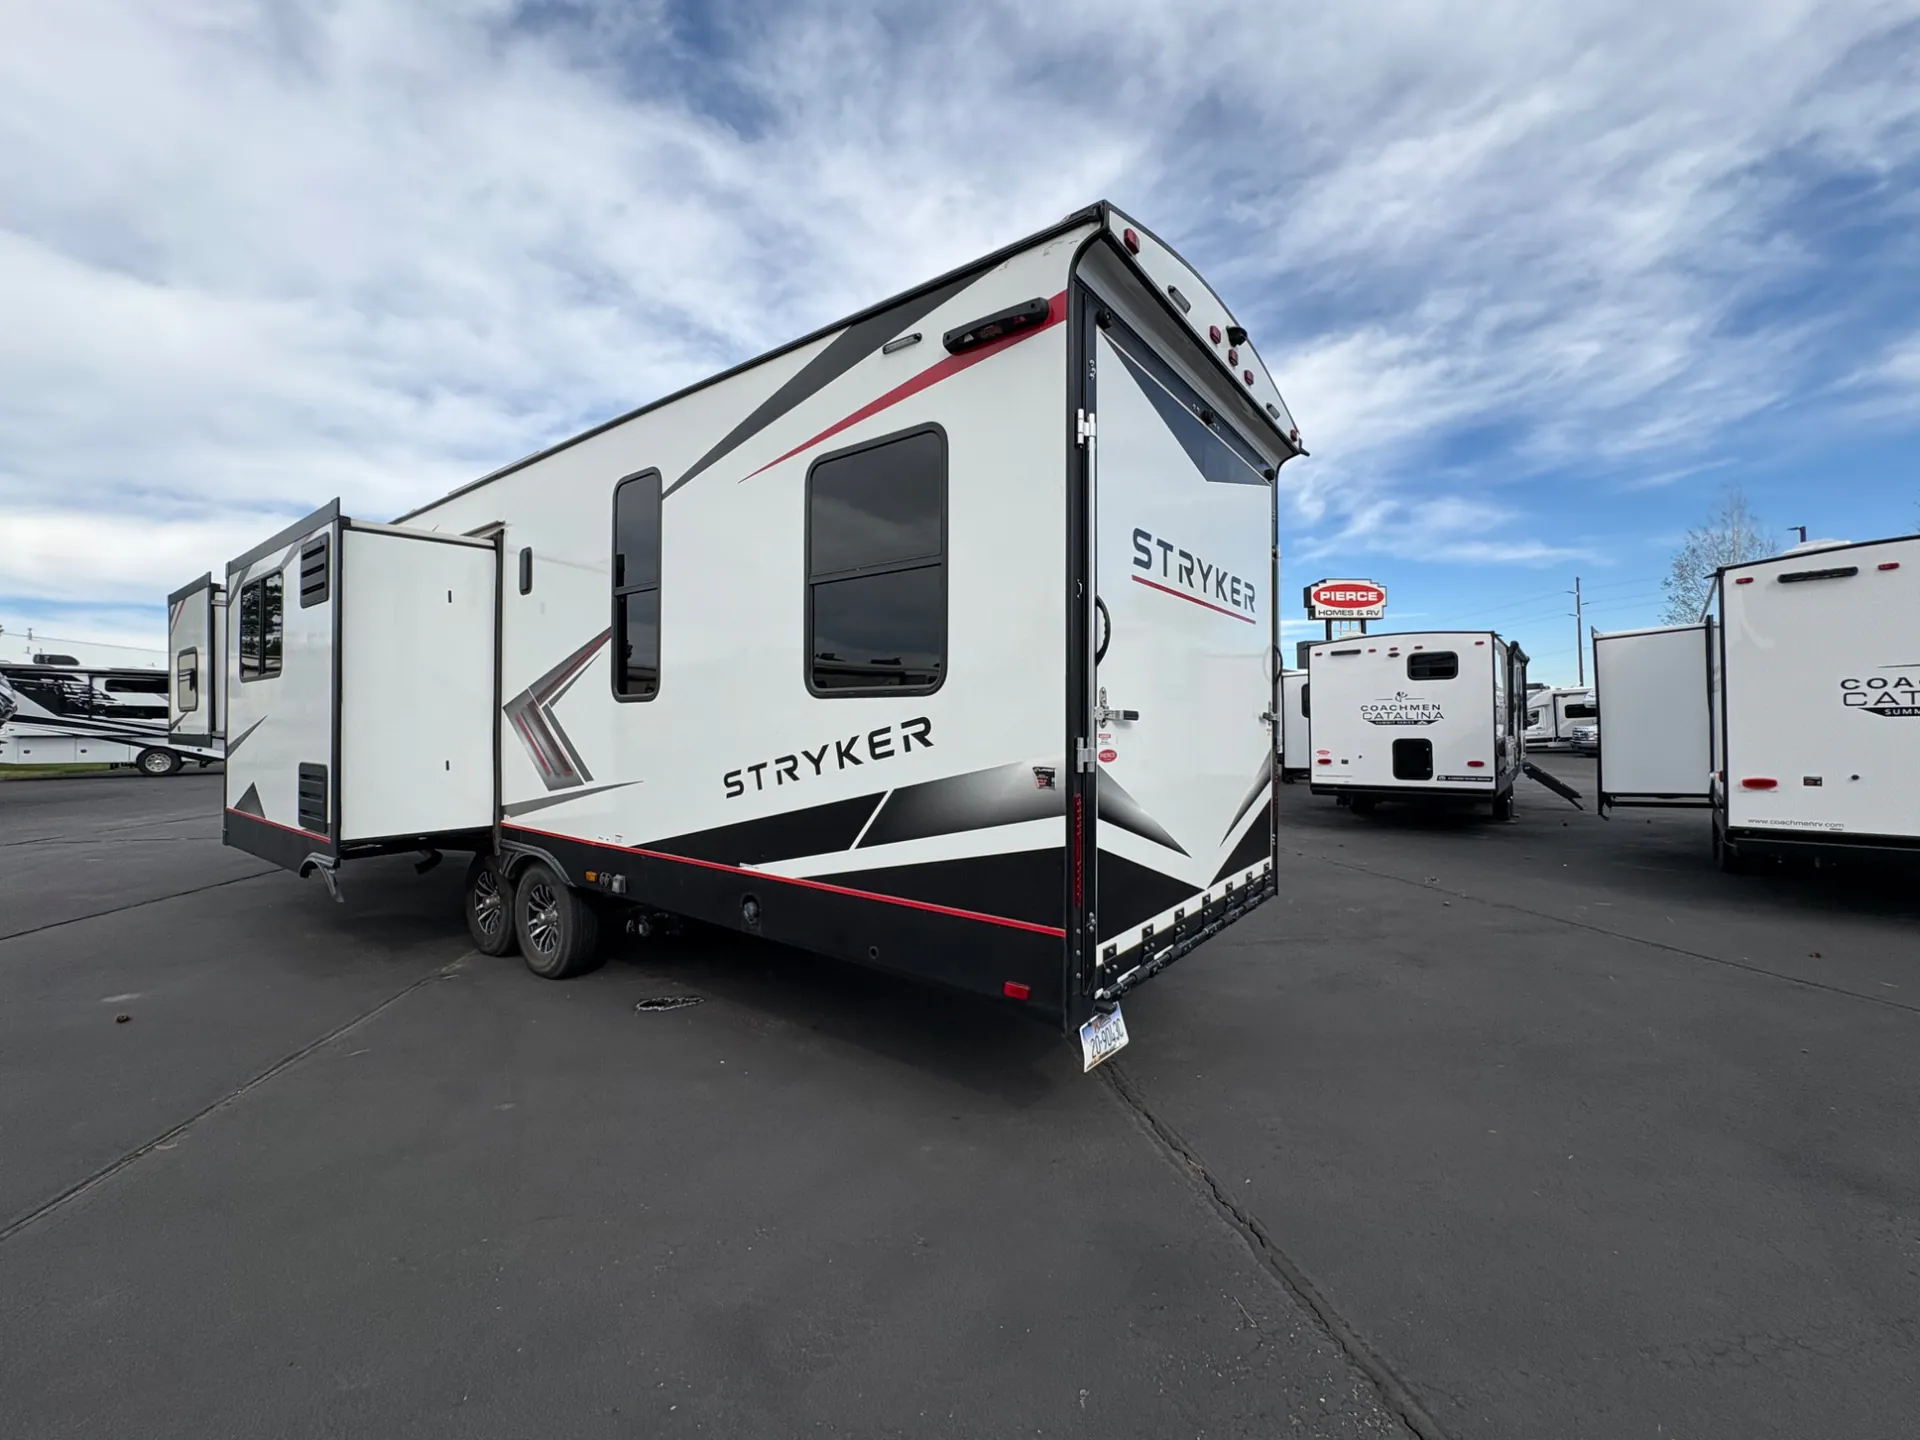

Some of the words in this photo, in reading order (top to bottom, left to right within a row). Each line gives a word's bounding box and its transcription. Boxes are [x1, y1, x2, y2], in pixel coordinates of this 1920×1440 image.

[1132, 527, 1256, 613] STRYKER
[1319, 591, 1378, 601] PIERCE
[1840, 676, 1920, 690] COA
[1360, 704, 1441, 712] COACHMEN
[1362, 711, 1445, 720] CATALINA
[723, 716, 934, 799] STRYKER
[1747, 819, 1845, 829] www.coachmenrv.com
